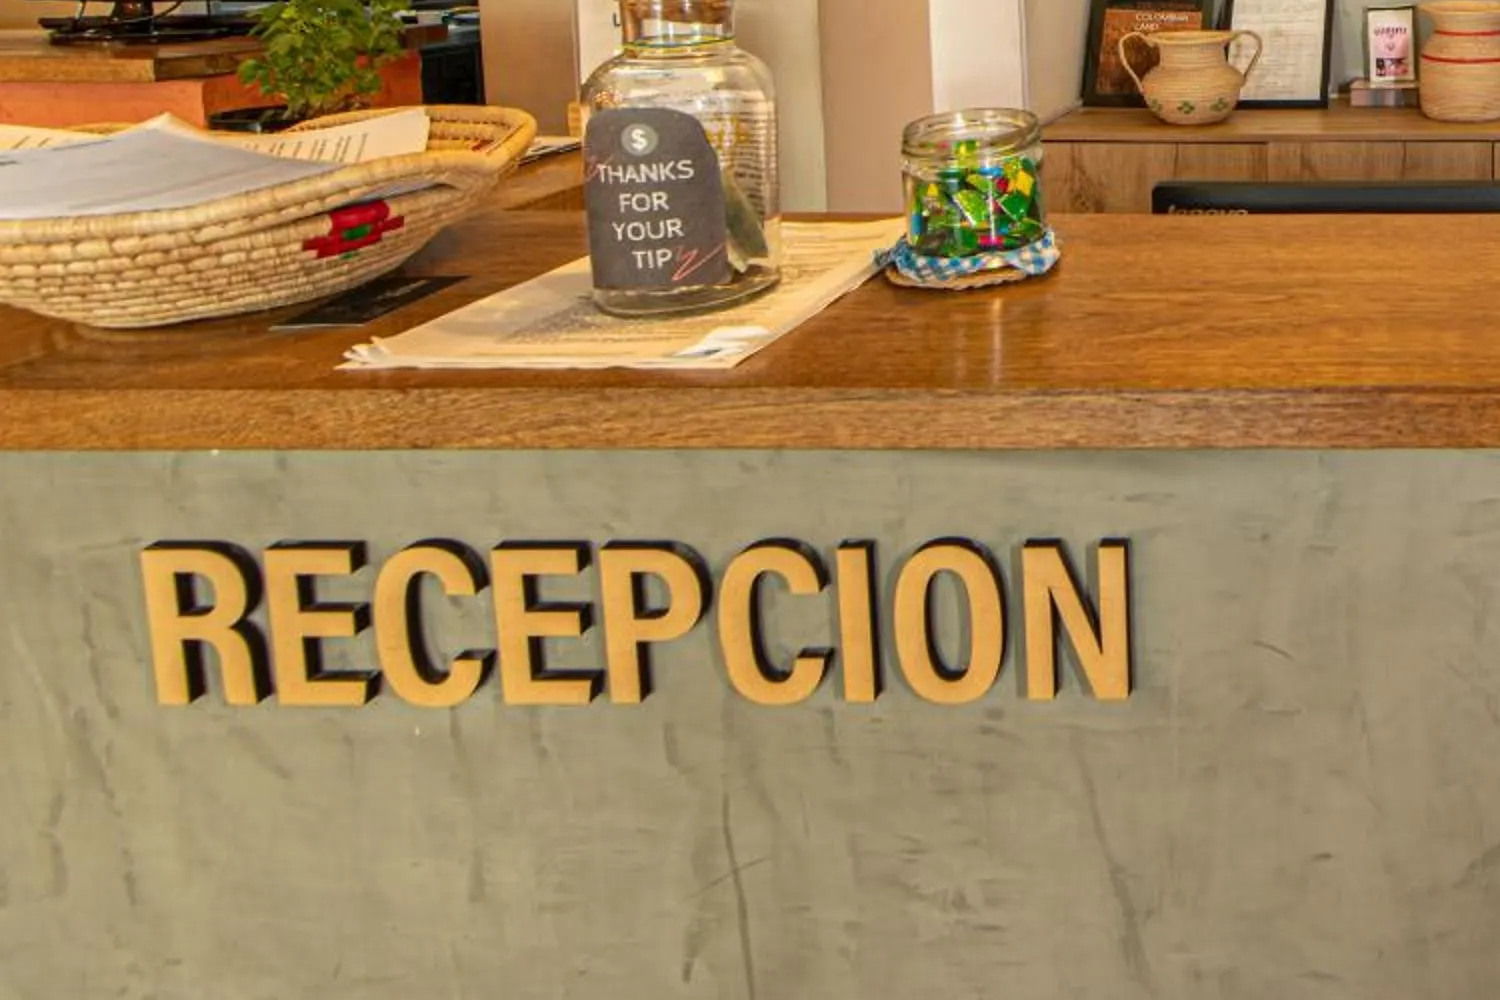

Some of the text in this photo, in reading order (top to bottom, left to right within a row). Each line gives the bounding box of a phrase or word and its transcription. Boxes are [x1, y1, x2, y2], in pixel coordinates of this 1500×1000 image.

[599, 159, 695, 185] THANKS
[619, 191, 670, 214] FOR
[612, 218, 685, 242] YOUR
[631, 249, 673, 270] TIP
[140, 538, 1132, 707] RECEPCION
